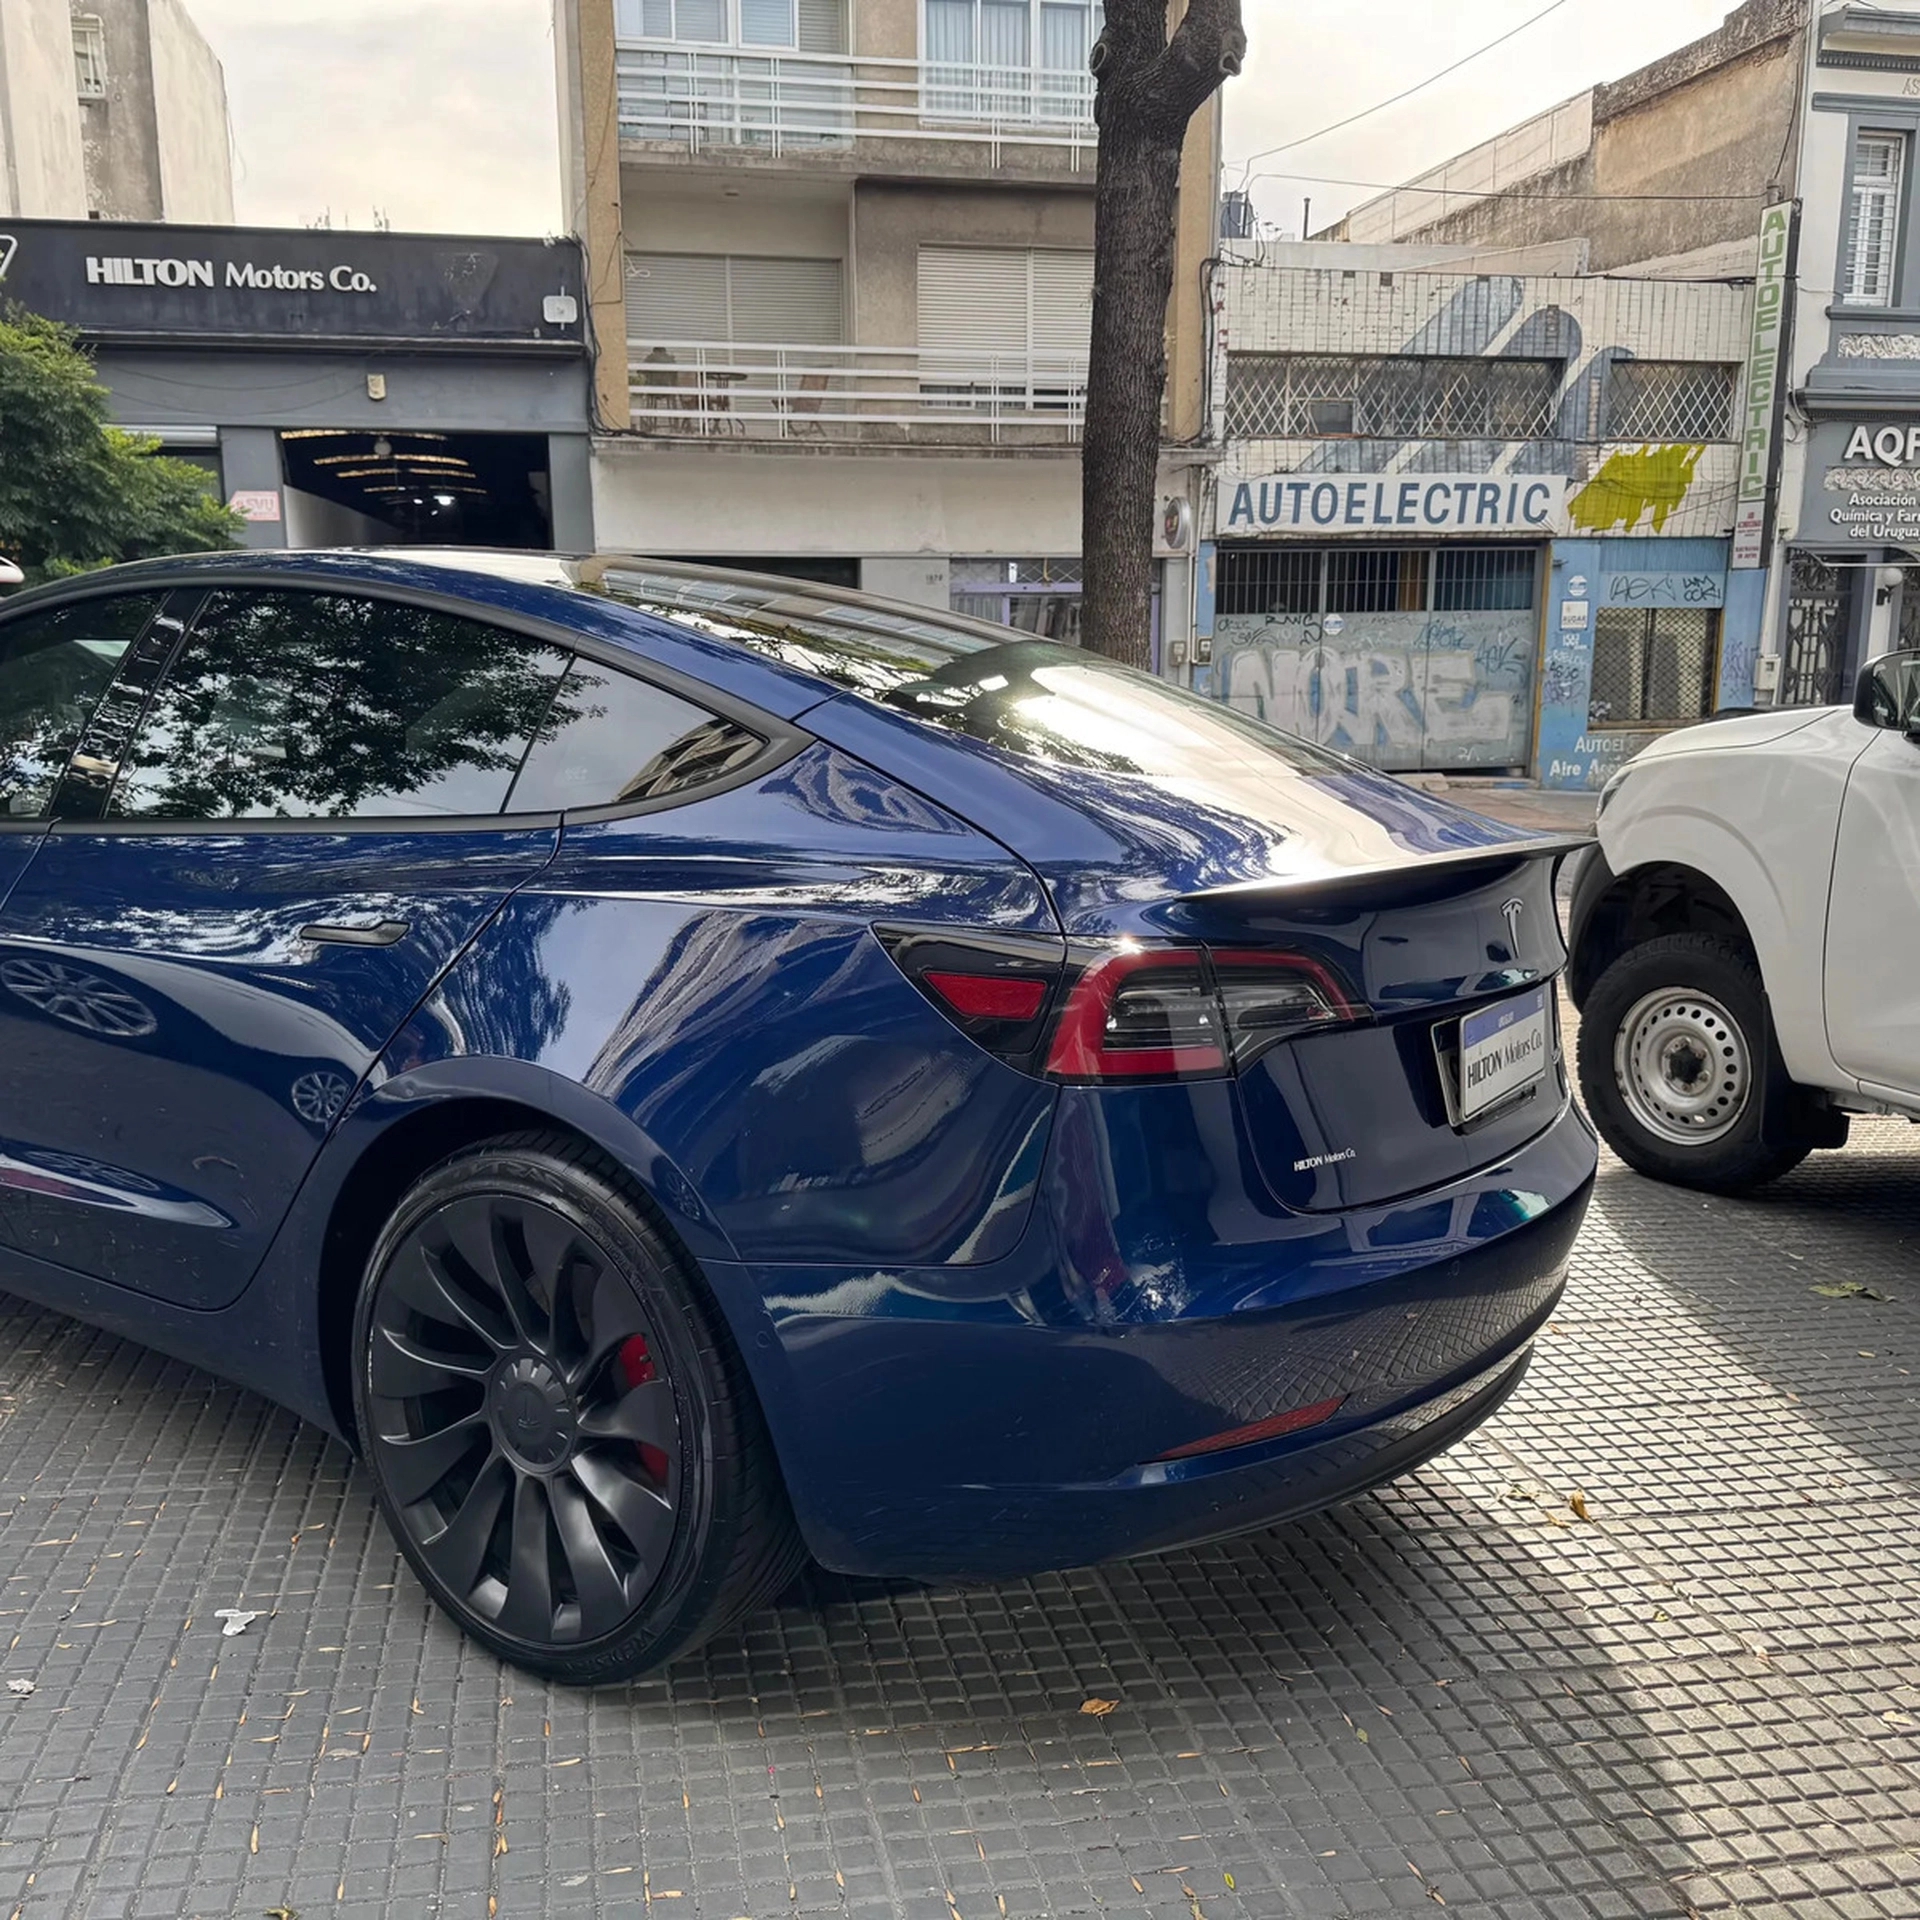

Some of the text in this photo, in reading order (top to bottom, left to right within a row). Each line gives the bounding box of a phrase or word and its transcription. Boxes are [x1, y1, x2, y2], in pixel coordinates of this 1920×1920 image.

[86, 256, 377, 292] HILTON Motors Co.
[1744, 209, 1787, 499] AUTOELECTRIC
[1228, 482, 1550, 525] AUTOELECTRIC
[1849, 492, 1916, 506] Asociación
[1830, 508, 1883, 524] Química
[1885, 513, 1894, 526] y
[1850, 525, 1920, 541] del Urugua
[1549, 760, 1581, 777] Aire
[1467, 1028, 1543, 1088] HILTON Motors Co.
[1293, 1155, 1323, 1171] HILTON
